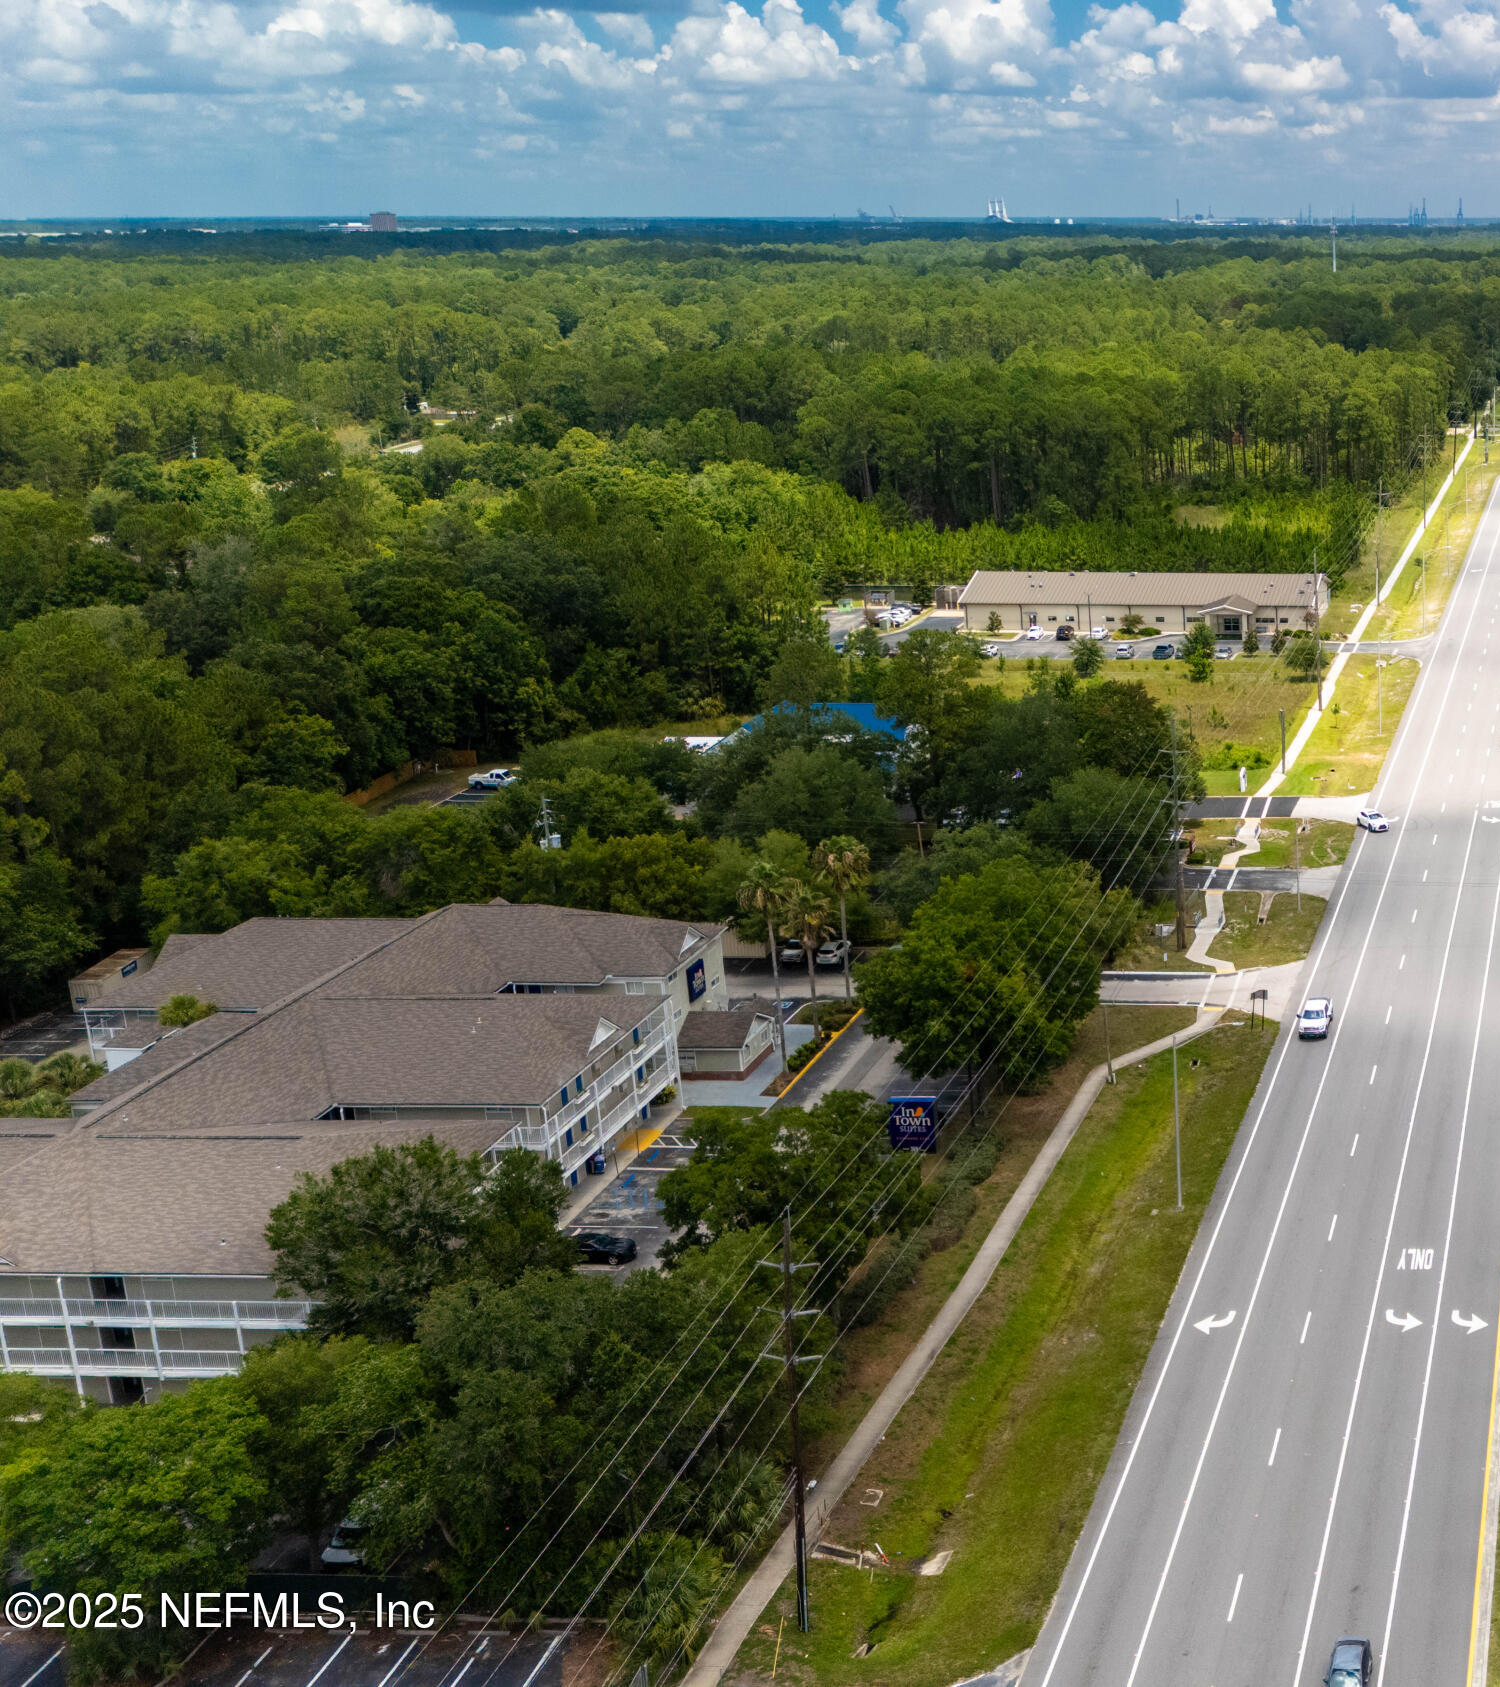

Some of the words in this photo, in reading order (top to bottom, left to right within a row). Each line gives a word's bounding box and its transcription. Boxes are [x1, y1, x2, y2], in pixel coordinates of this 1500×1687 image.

[901, 1107, 916, 1117] In
[893, 1115, 932, 1126] Town
[1396, 1247, 1435, 1270] ONLY
